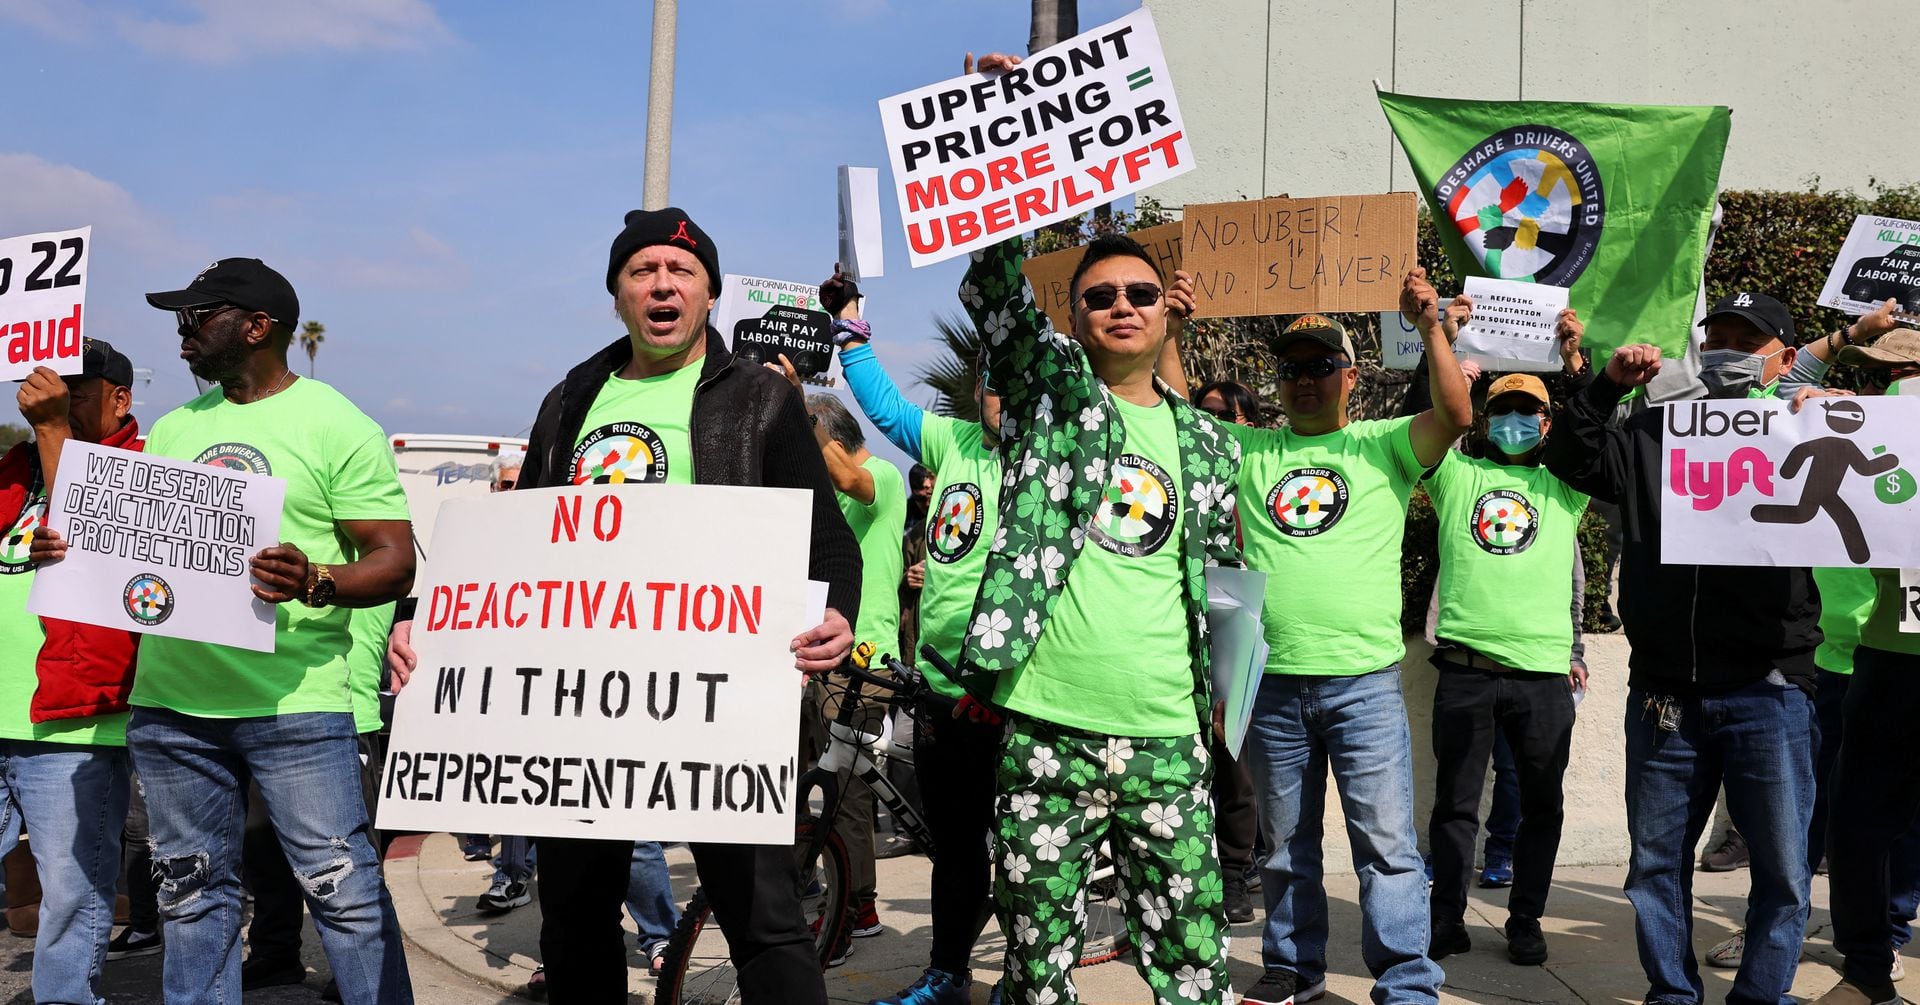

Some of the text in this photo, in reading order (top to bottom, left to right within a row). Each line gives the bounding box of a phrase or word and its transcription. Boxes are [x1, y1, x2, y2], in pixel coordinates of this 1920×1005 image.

[901, 25, 1133, 130] UPFRONT
[901, 82, 1111, 172] PRICING
[905, 99, 1172, 213] MORE FOR
[907, 131, 1183, 255] UBER/LYFT
[1514, 131, 1578, 159] DRIVERS
[1576, 159, 1599, 226] UNITED
[1876, 229, 1904, 243] KILL
[25, 237, 84, 292] 22
[1880, 257, 1910, 270] FAIR
[1903, 250, 1920, 258] REST
[741, 278, 788, 291] CALIFORNIA
[1856, 268, 1897, 282] LABOR
[747, 289, 775, 304] KILL
[1476, 304, 1542, 317] EXPLOITATION
[1490, 295, 1533, 305] REFUSING
[1733, 292, 1753, 307] LA
[760, 319, 818, 337] FAIR PAY
[778, 310, 808, 321] RESTORE
[740, 330, 830, 353] LABOR RIGHTS
[1667, 402, 1778, 438] Uber
[219, 445, 256, 459] DRIVERS
[612, 423, 651, 440] RIDERS
[650, 439, 666, 478] UNITED
[85, 452, 247, 511] WE DESERVE
[1121, 456, 1176, 520] RIDERS UNITED
[1301, 469, 1331, 477] RIDERS
[1332, 475, 1347, 500] UNITED
[1670, 446, 1774, 512] lyft
[1501, 490, 1527, 504] RIDERS
[63, 483, 256, 547] DEACTIVATION
[551, 494, 623, 544] NO
[973, 503, 982, 535] UNITED
[67, 518, 245, 577] PROTECTIONS
[1099, 538, 1118, 551] JOIN
[427, 580, 762, 634] DEACTIVATION
[434, 666, 729, 723] WITHOUT
[386, 751, 790, 814] REPRESENTATION
